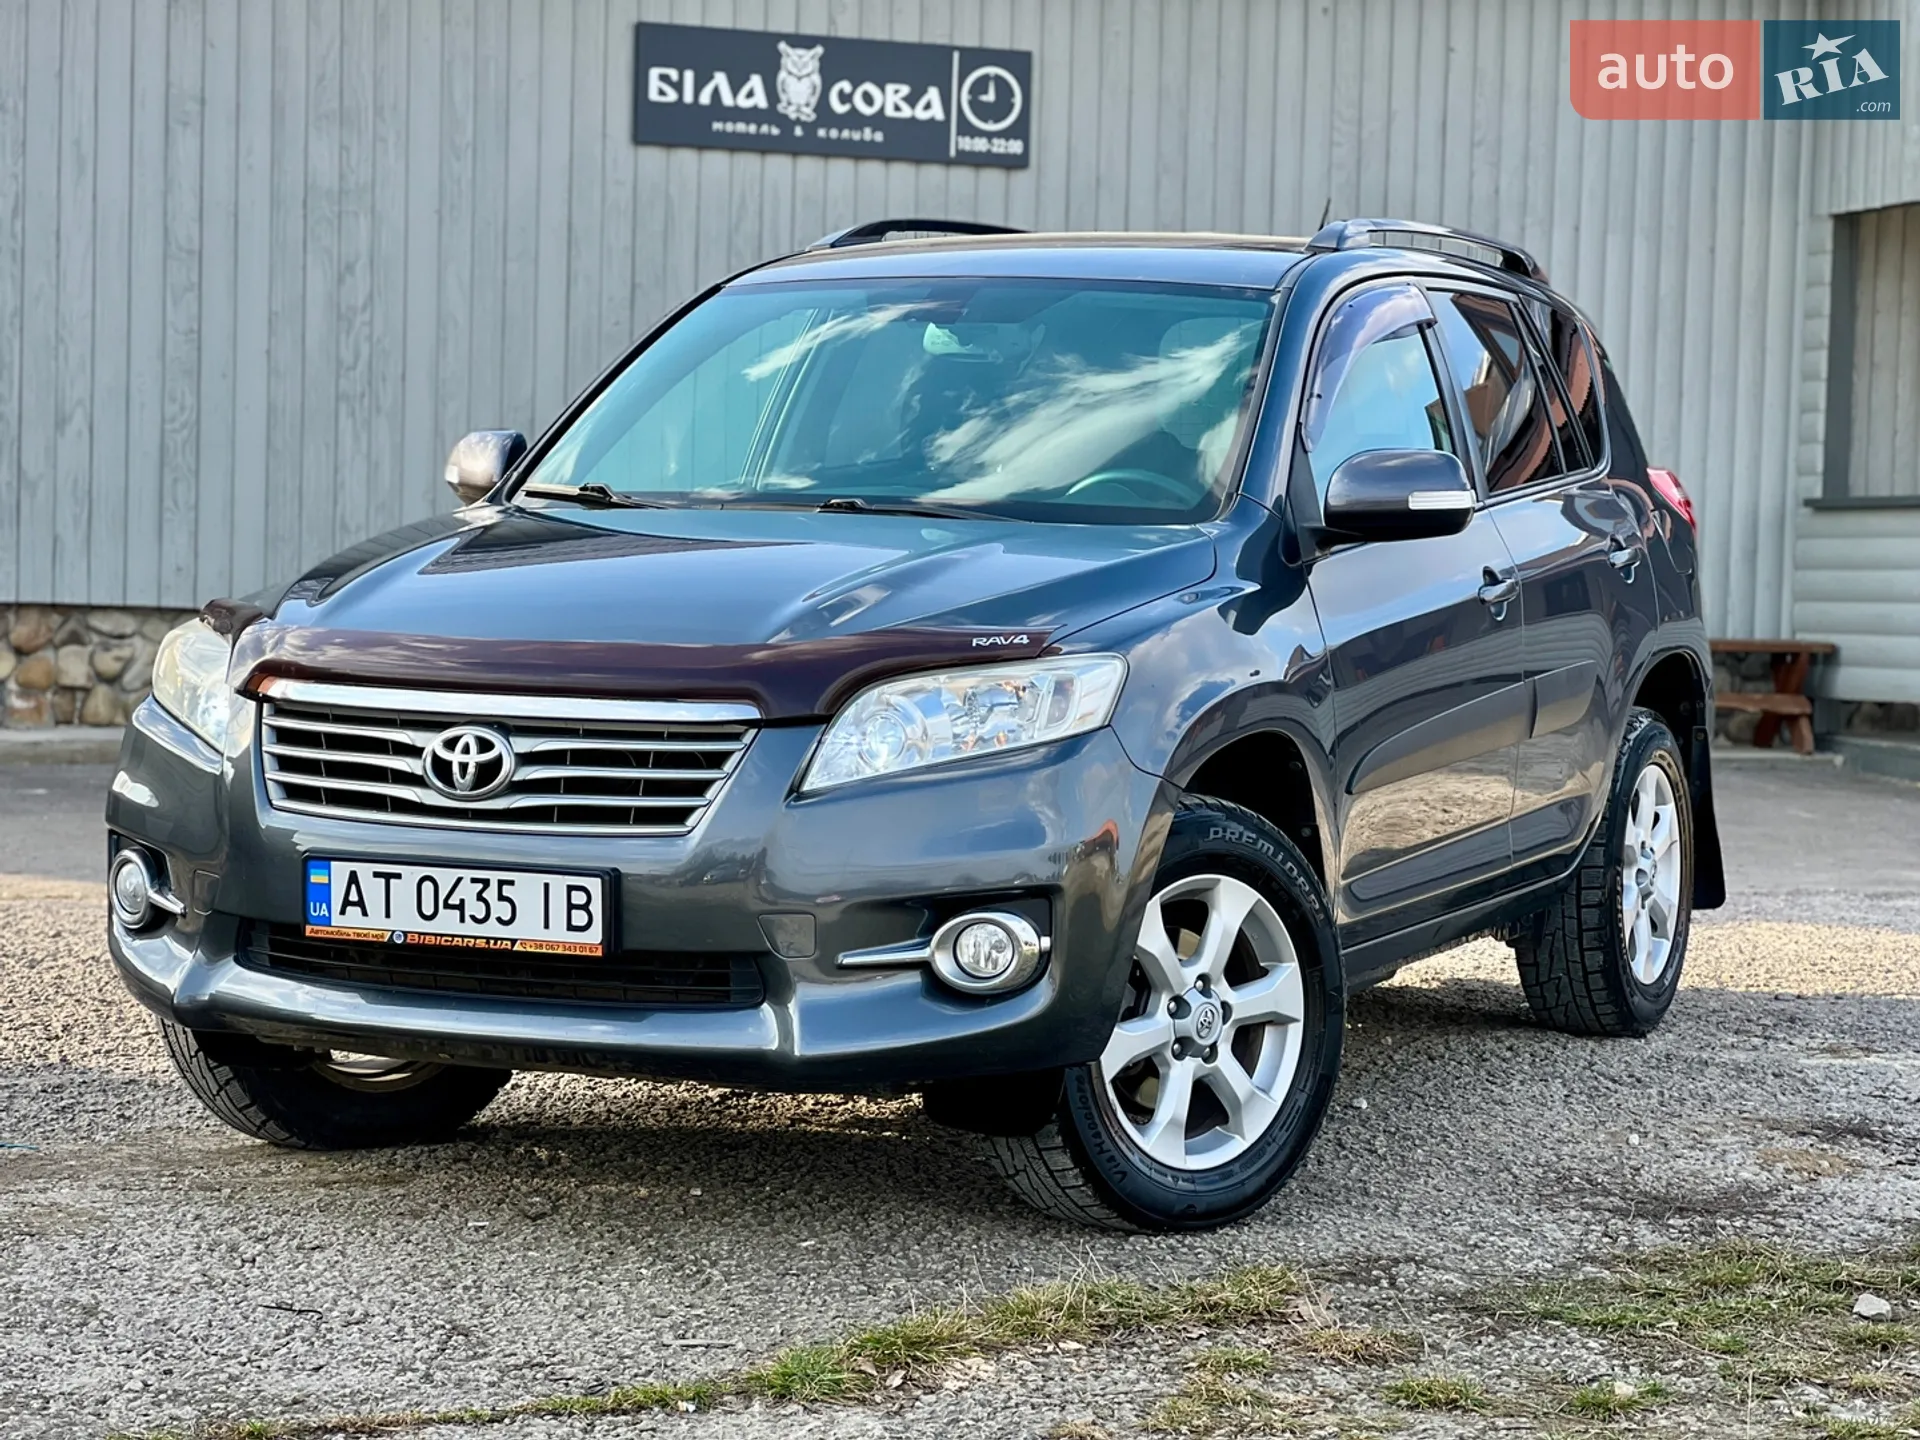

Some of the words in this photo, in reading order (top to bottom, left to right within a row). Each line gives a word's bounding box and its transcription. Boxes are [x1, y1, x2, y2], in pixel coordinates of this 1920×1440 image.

[647, 67, 769, 109] БІЛА
[828, 80, 945, 121] СОВА
[971, 634, 1030, 647] RAV4
[339, 869, 403, 919] AT
[415, 874, 518, 926] 0435
[310, 901, 329, 918] UA
[528, 943, 544, 951] +38
[545, 943, 560, 952] 067
[561, 944, 578, 953] 343
